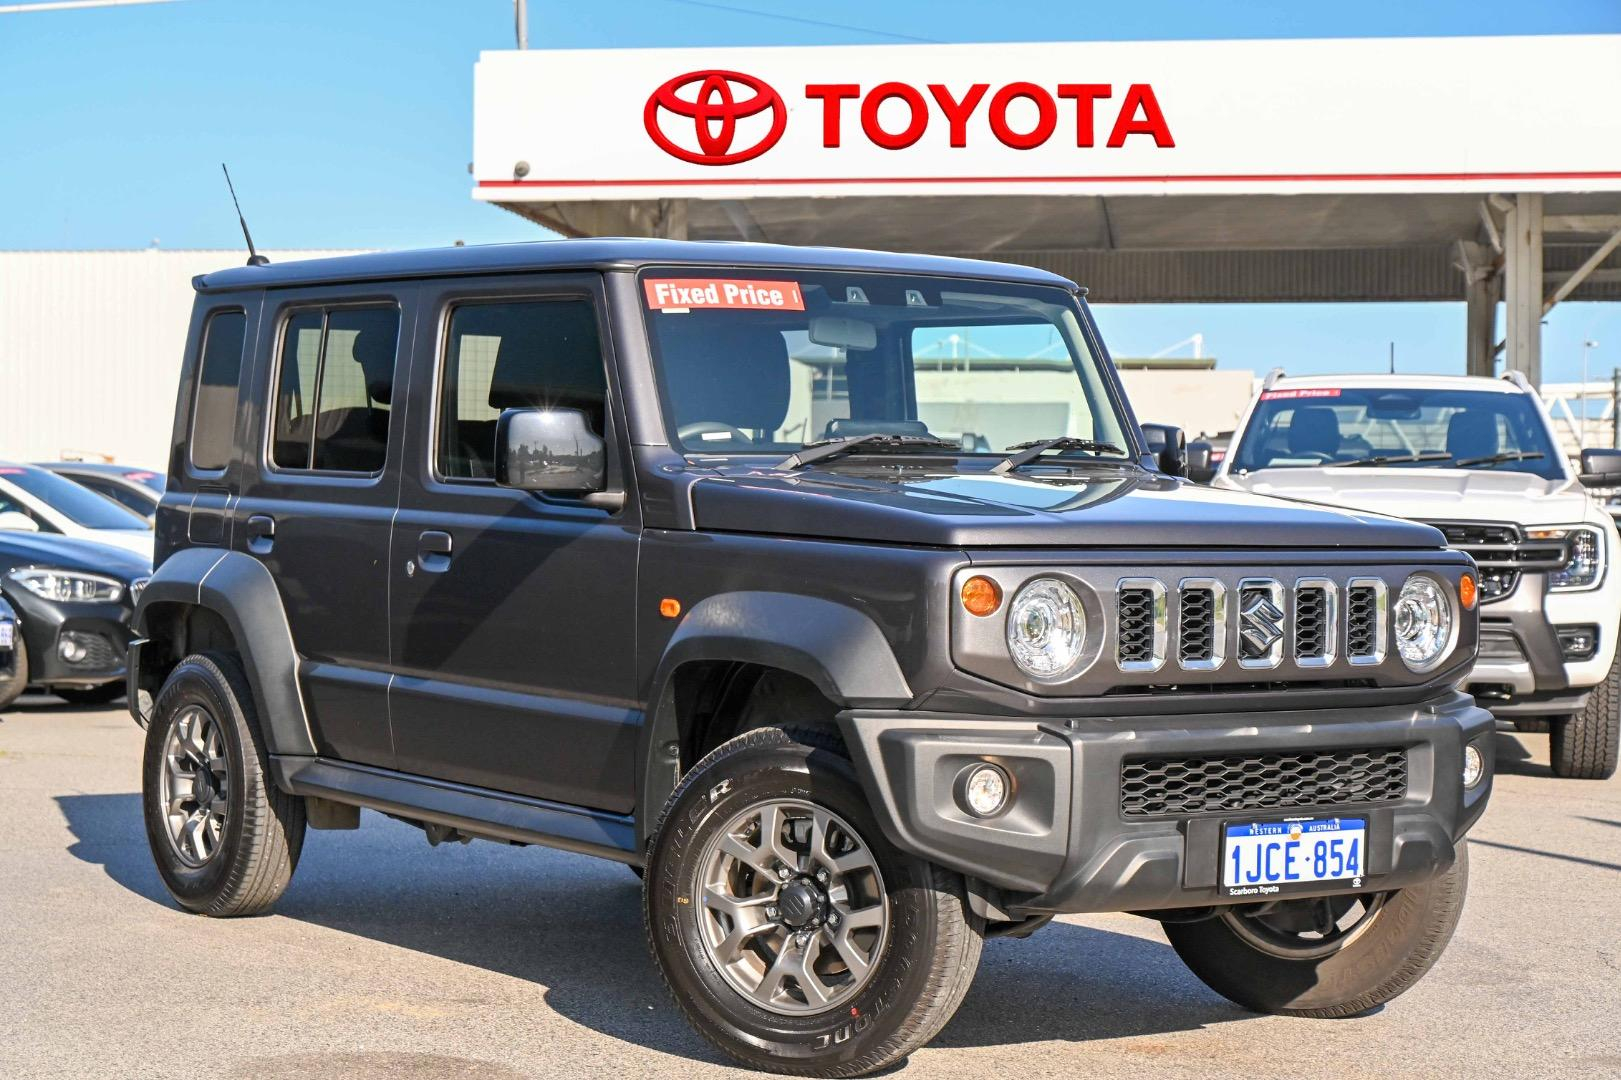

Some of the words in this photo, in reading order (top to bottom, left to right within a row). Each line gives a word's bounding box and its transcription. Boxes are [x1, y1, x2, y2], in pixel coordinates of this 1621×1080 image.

[805, 81, 1176, 150] TOYOTA
[654, 283, 720, 305] Fixed
[723, 283, 785, 306] Price
[1309, 823, 1340, 832] AUSTRALIA
[1229, 887, 1259, 896] Scarboro
[1259, 885, 1280, 895] Toyota
